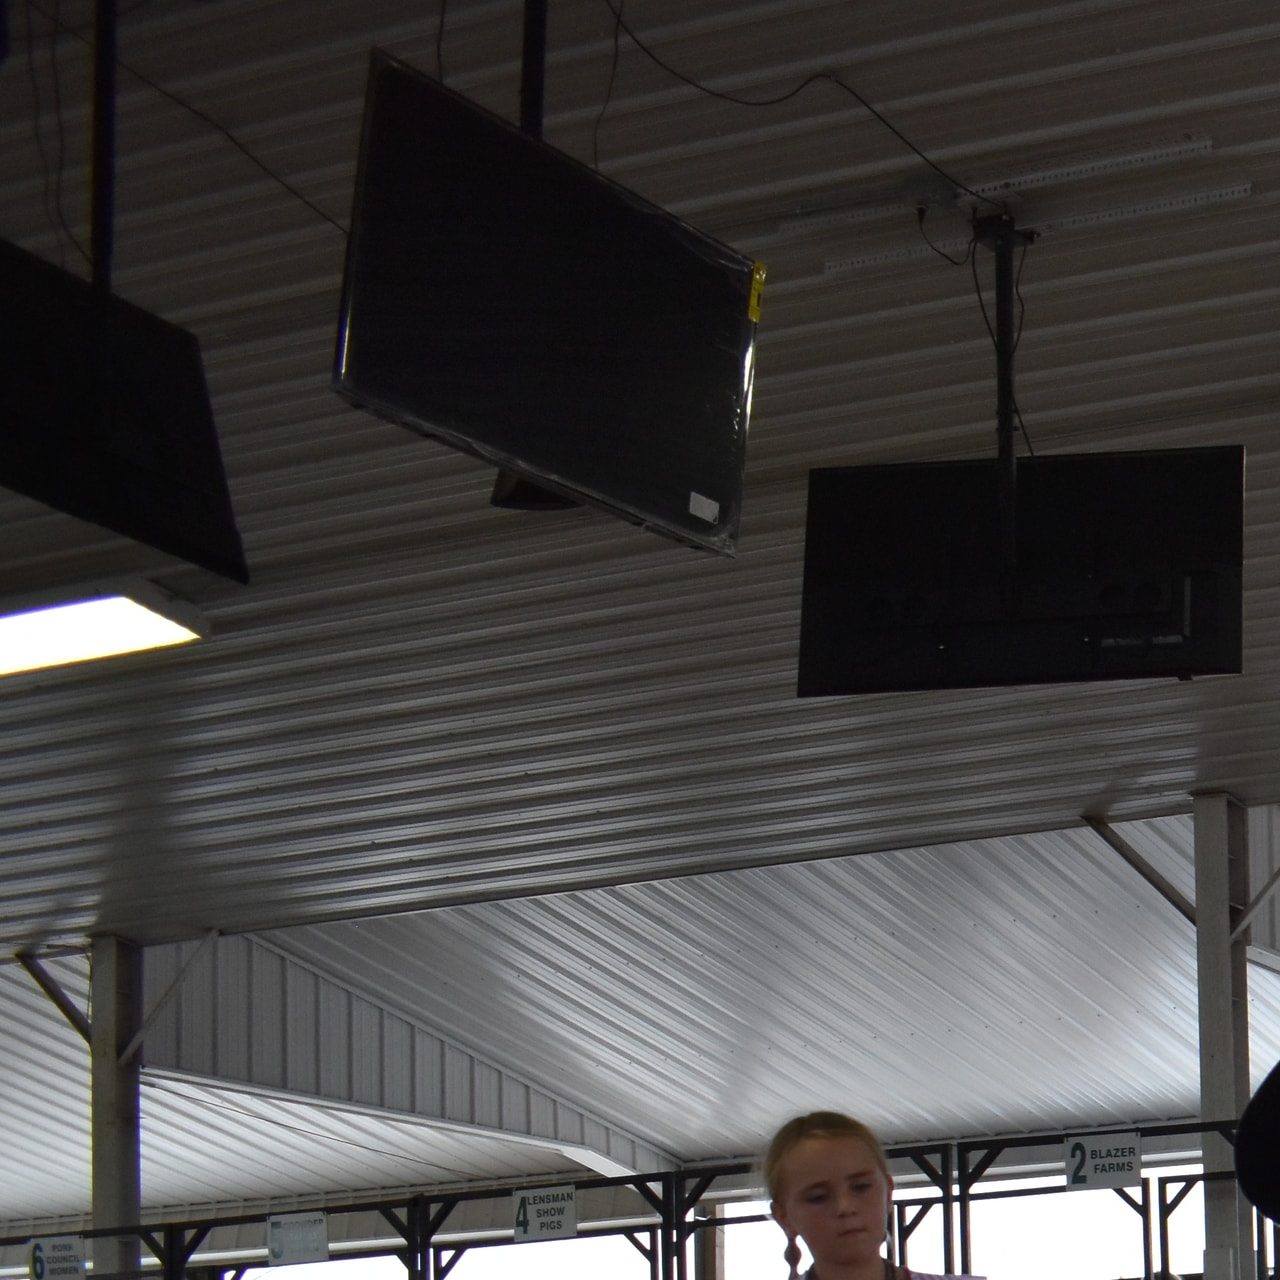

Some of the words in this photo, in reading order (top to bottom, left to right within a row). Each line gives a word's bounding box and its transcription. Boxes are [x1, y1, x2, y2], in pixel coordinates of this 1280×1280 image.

[1090, 1147, 1136, 1160] BLAZER
[1071, 1142, 1087, 1184] 2
[1094, 1161, 1133, 1174] FARMS
[527, 1191, 573, 1206] LENSMAN
[516, 1196, 529, 1235] 4
[536, 1206, 566, 1218] SHOW
[539, 1220, 562, 1231] PIGS
[32, 1242, 45, 1280] 6
